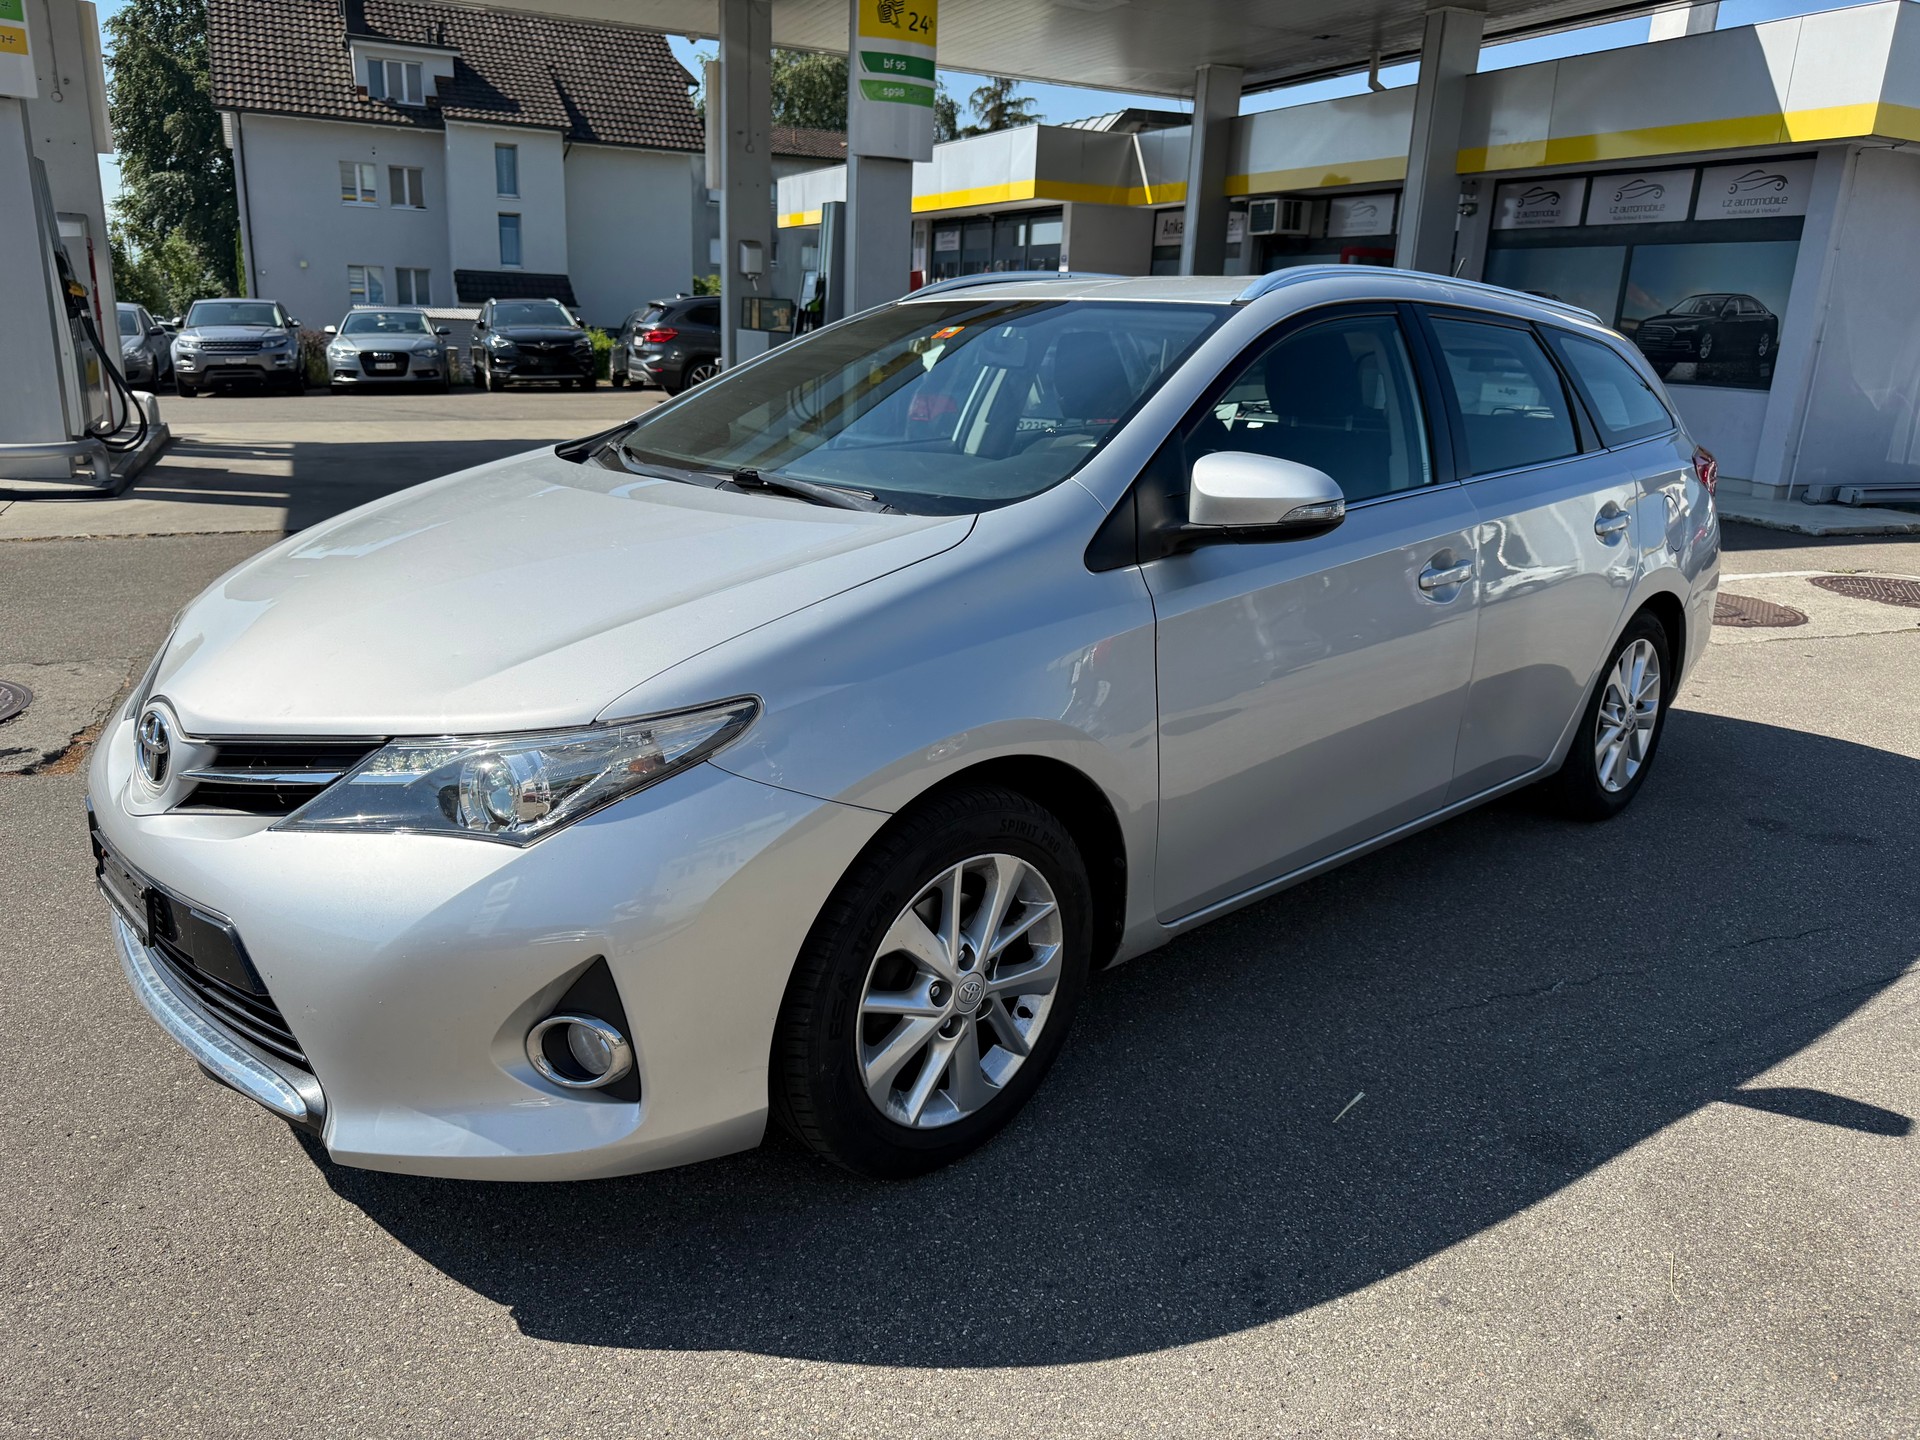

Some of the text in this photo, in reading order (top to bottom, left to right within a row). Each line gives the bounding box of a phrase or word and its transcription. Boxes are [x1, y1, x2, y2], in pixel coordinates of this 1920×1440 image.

[895, 60, 907, 71] 95
[1722, 199, 1733, 208] LZ
[1609, 206, 1618, 214] LZ
[999, 818, 1061, 853] SPIRIT PRO
